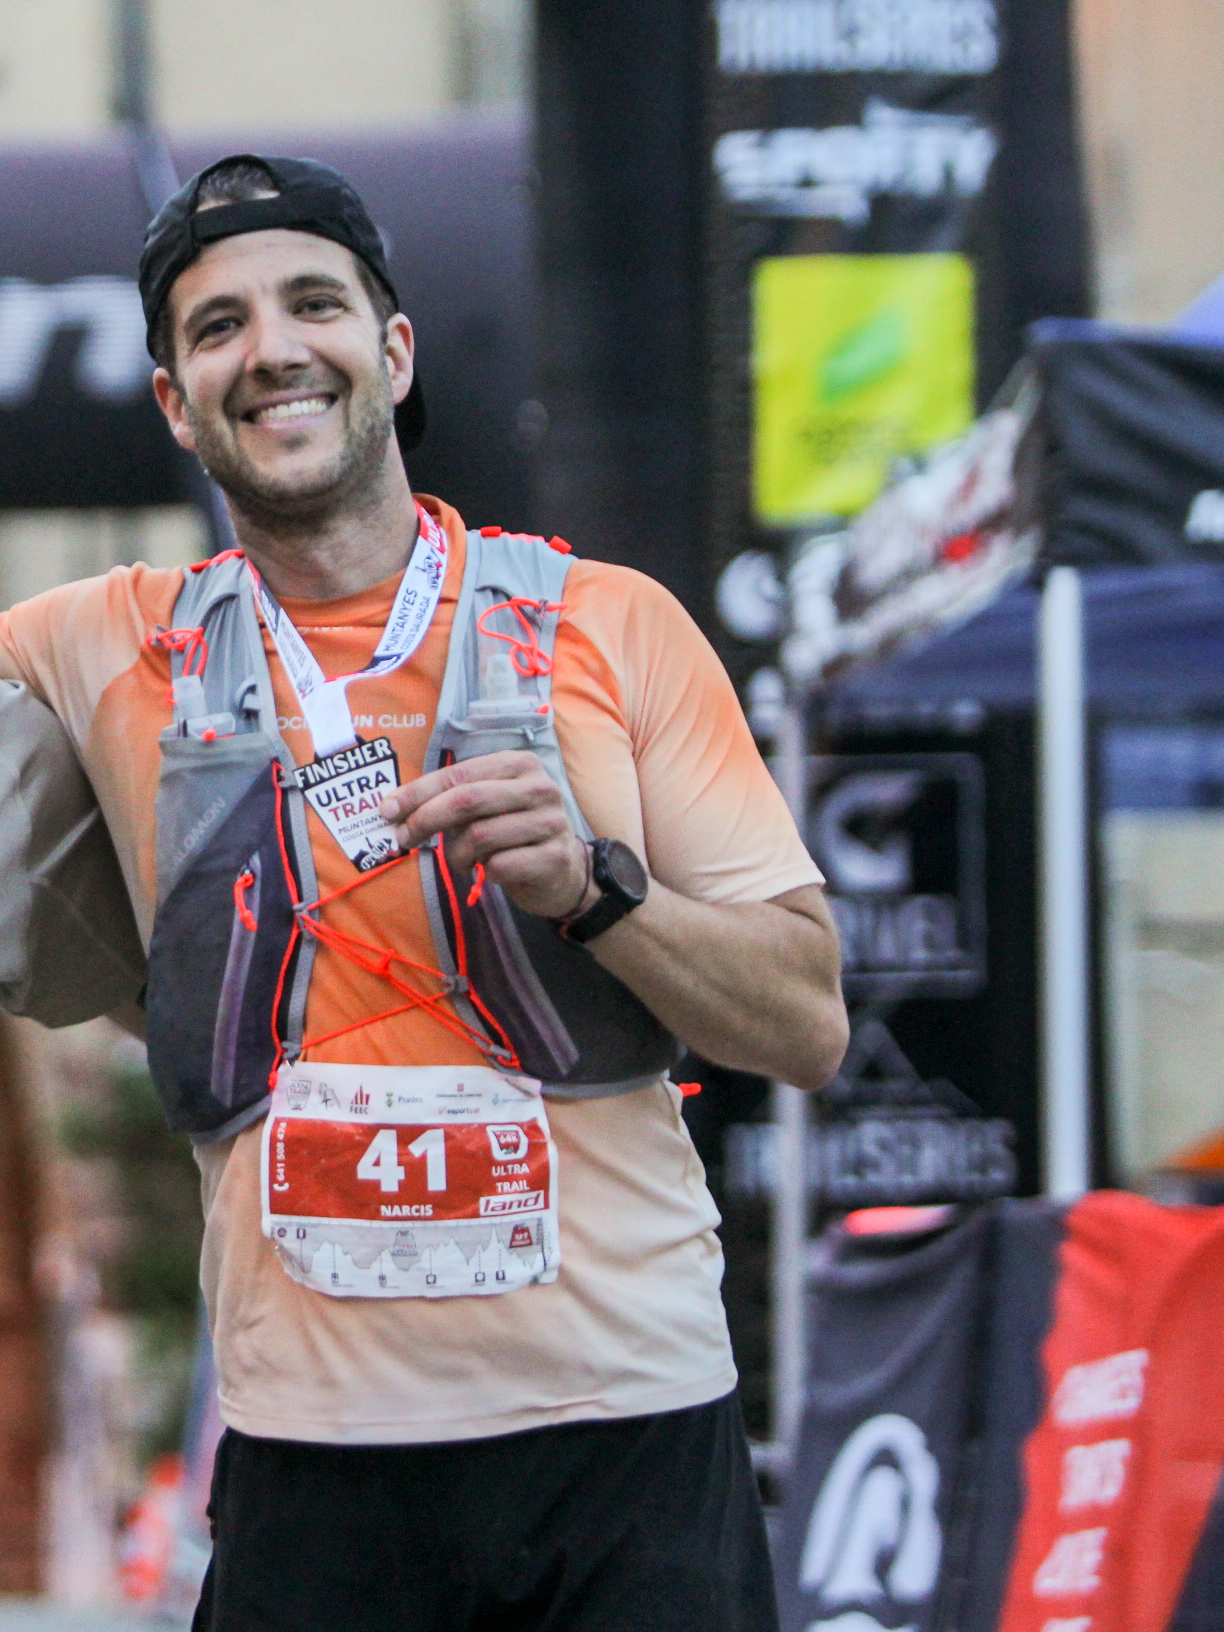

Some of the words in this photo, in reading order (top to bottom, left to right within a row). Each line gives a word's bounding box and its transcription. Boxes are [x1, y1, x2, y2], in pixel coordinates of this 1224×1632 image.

[384, 587, 418, 651] MUNTANYES
[378, 712, 427, 729] CLUB
[293, 738, 393, 788] FINISHER
[315, 770, 391, 807] ULTRA
[356, 1128, 447, 1192] 41
[492, 1162, 530, 1177] ULTRA
[277, 1163, 286, 1182] 641
[496, 1179, 531, 1194] TRAIL
[380, 1203, 434, 1217] NARCIS
[483, 1192, 541, 1213] land
